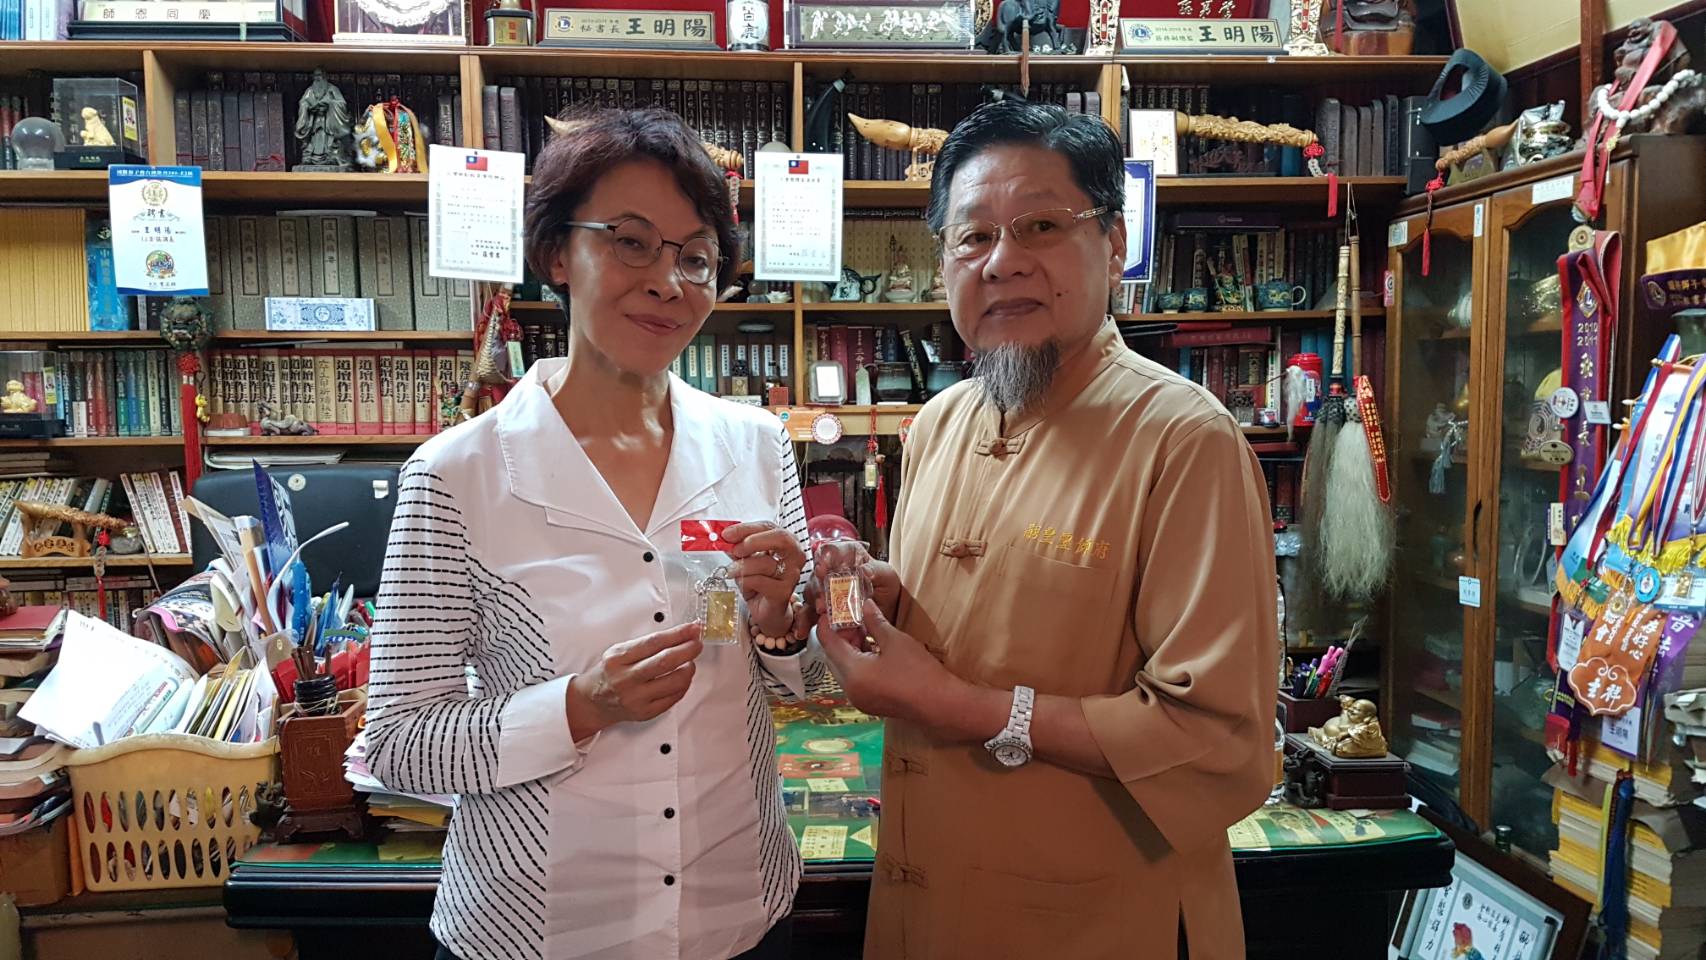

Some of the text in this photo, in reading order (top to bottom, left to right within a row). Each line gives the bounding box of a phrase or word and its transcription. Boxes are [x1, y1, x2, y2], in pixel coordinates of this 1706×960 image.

[625, 17, 707, 37] 王明陽
[1199, 25, 1274, 44] 王明陽
[1578, 323, 1599, 333] 2010
[1576, 336, 1599, 346] 2011
[336, 359, 353, 404] 道壇作法
[359, 359, 375, 404] 道壇作法
[395, 359, 412, 404] 道壇作法
[415, 359, 431, 404] 道壇作法
[1587, 677, 1623, 702] 吉祥
